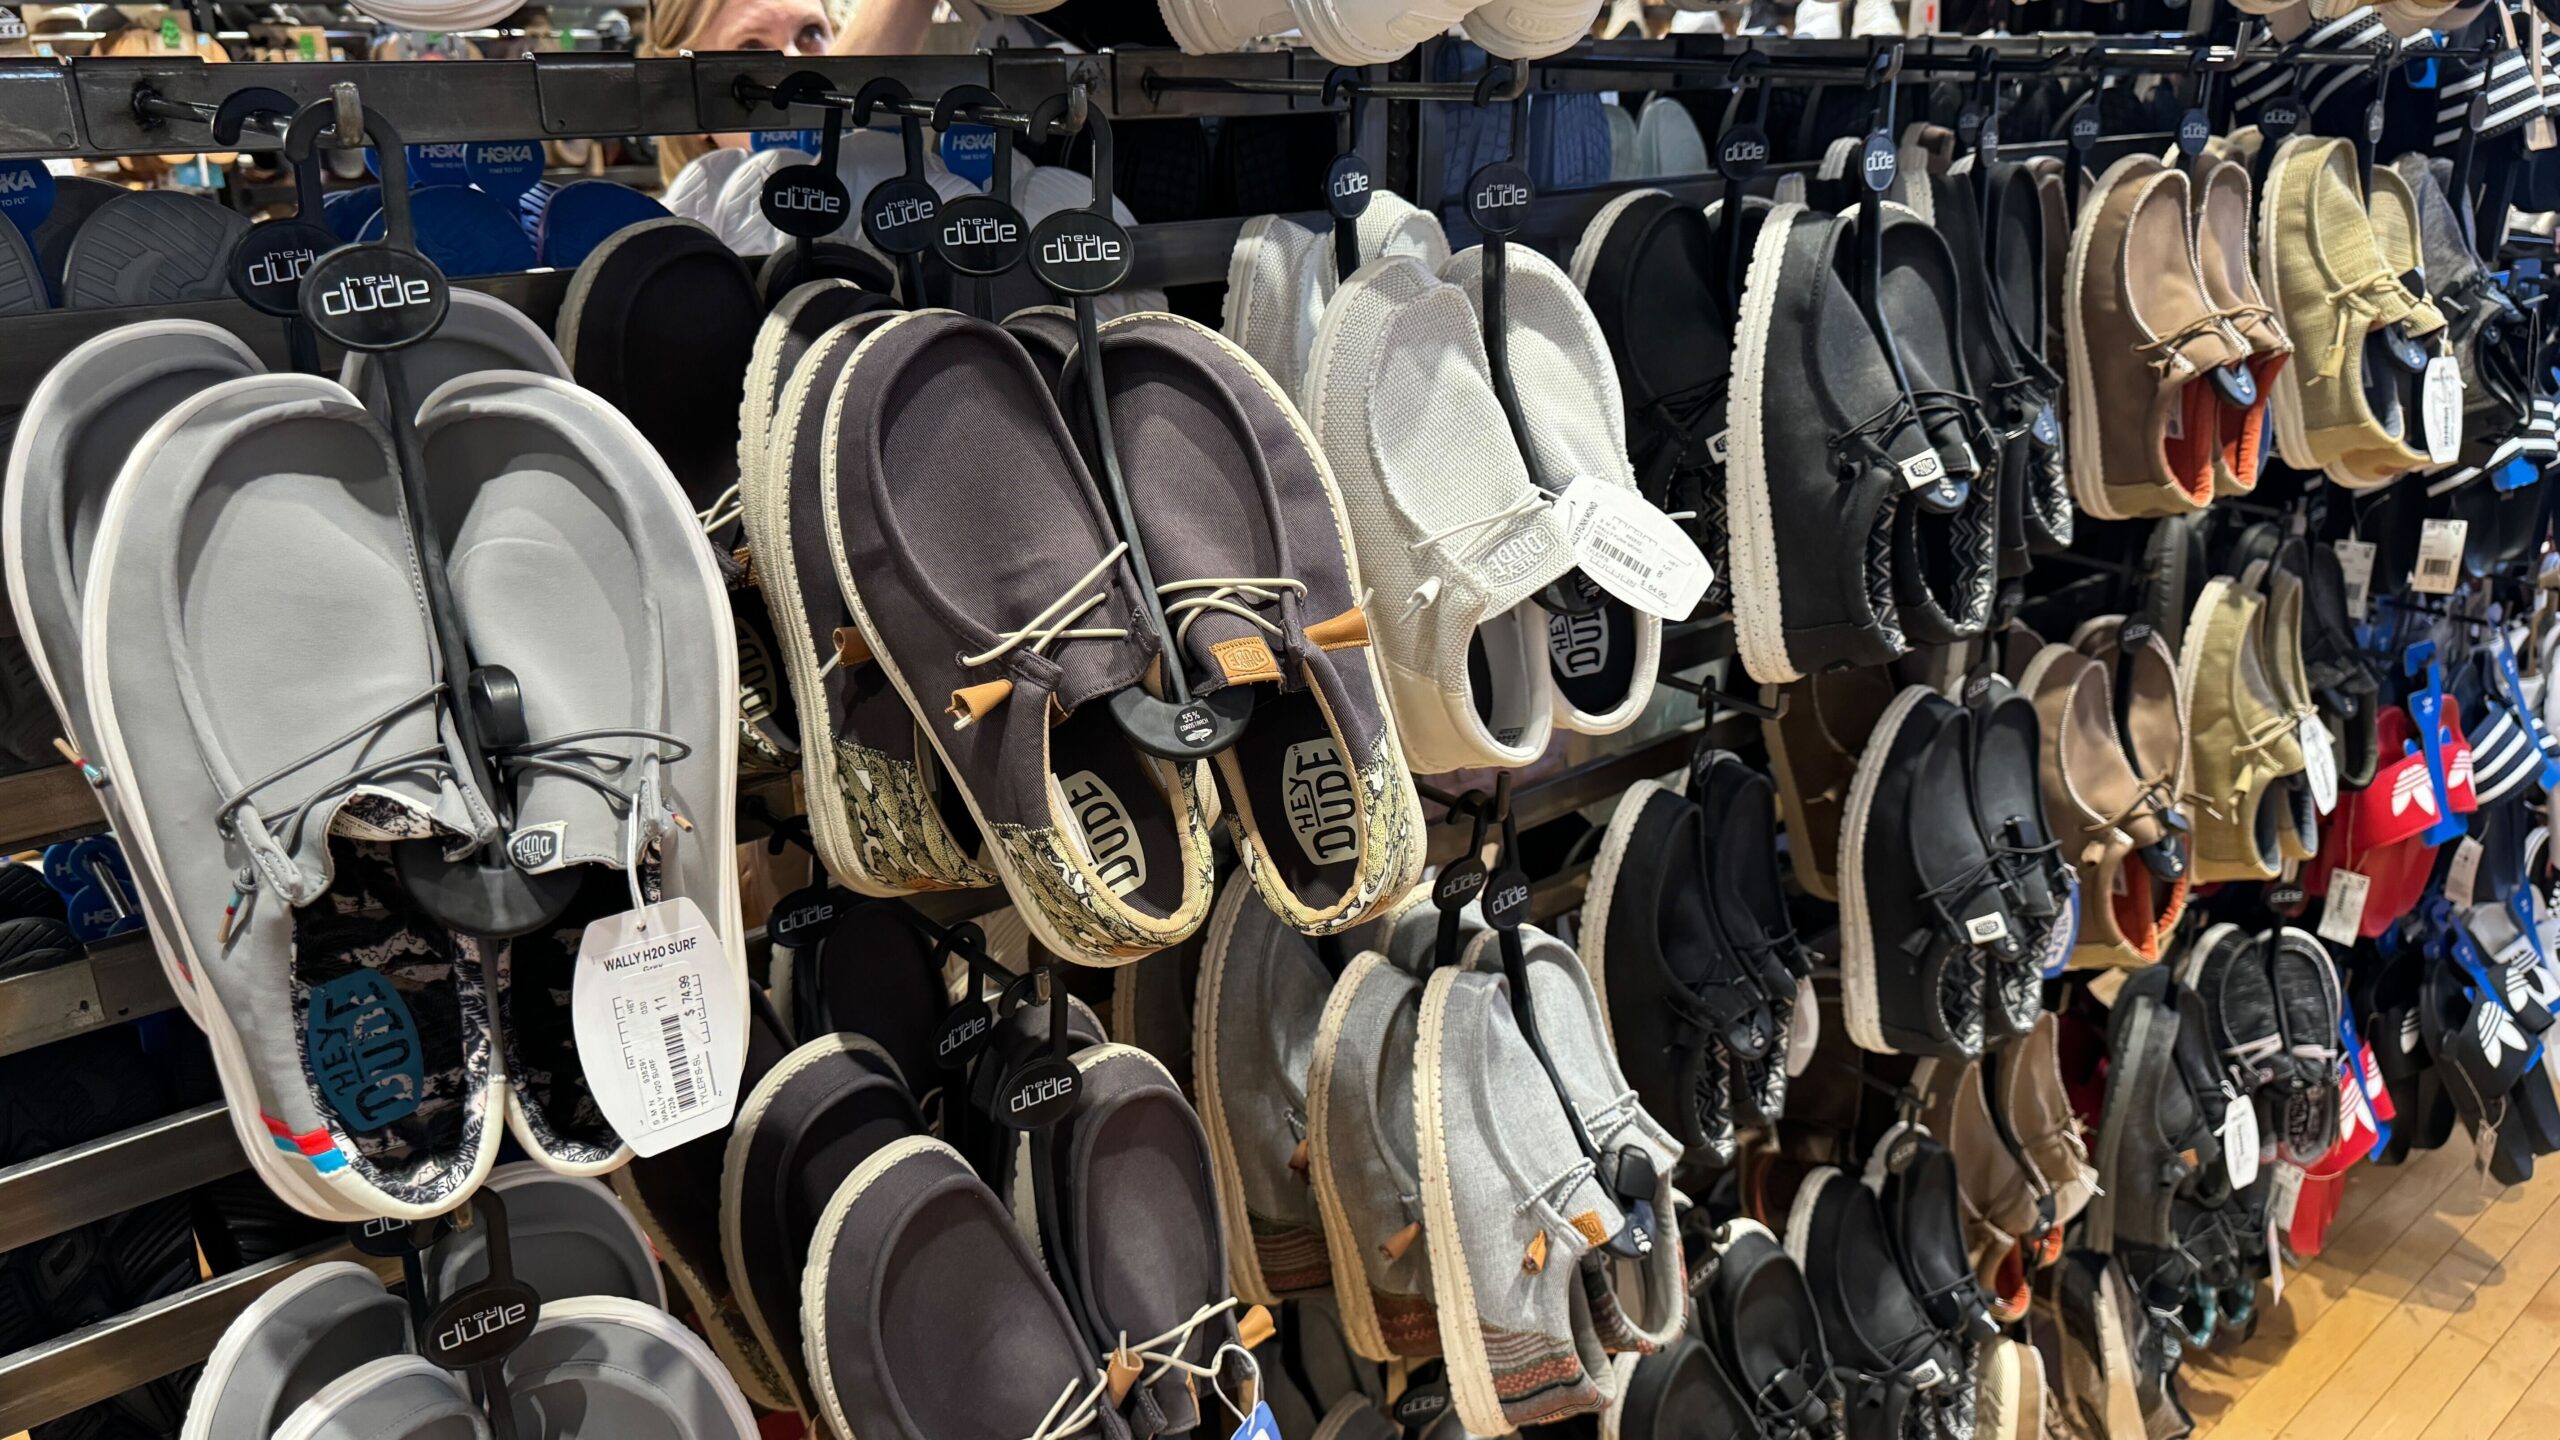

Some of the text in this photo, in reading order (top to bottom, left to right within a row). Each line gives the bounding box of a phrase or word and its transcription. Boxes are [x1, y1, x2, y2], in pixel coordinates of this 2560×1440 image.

[420, 144, 463, 158] HOK
[477, 145, 533, 164] HOKA
[953, 134, 993, 151] HOKA
[0, 170, 37, 194] KA
[792, 186, 821, 197] hey
[1334, 172, 1368, 197] dude
[1490, 184, 1511, 192] hey
[775, 188, 840, 213] dude
[888, 198, 914, 209] hey
[1477, 184, 1527, 209] dude
[876, 199, 934, 230] dude
[961, 217, 993, 228] hey
[944, 219, 1016, 246] dude
[1062, 234, 1096, 246] hey
[1043, 236, 1120, 263] dude
[249, 250, 315, 286] dud
[346, 274, 394, 288] hey
[322, 275, 430, 315] dude
[1486, 534, 1546, 577] DUDE
[1228, 649, 1264, 668] DUDE
[1179, 718, 1209, 732] CORNSTARCH
[1181, 711, 1201, 723] 55%
[1289, 777, 1316, 834] HEY
[1296, 748, 1356, 859] DUDE
[516, 835, 552, 860] DUDE
[1068, 781, 1140, 889] DUDE
[1492, 886, 1528, 914] dude
[779, 905, 833, 933] dude
[603, 951, 640, 972] WALLY
[668, 937, 697, 955] SURF
[679, 975, 693, 1004] 74.99
[626, 999, 635, 1014] HEY
[640, 1001, 648, 1014] 030
[655, 997, 668, 1011] 11
[940, 1017, 985, 1056] dude
[951, 1020, 973, 1034] hey
[317, 1027, 358, 1096] HEY
[325, 982, 415, 1121] DUDE
[649, 1059, 660, 1080] SURF
[1010, 1076, 1072, 1113] dude
[1025, 1078, 1053, 1091] hey
[657, 1096, 669, 1123] WALLY
[439, 1303, 526, 1350] dude
[459, 1306, 498, 1325] hey
